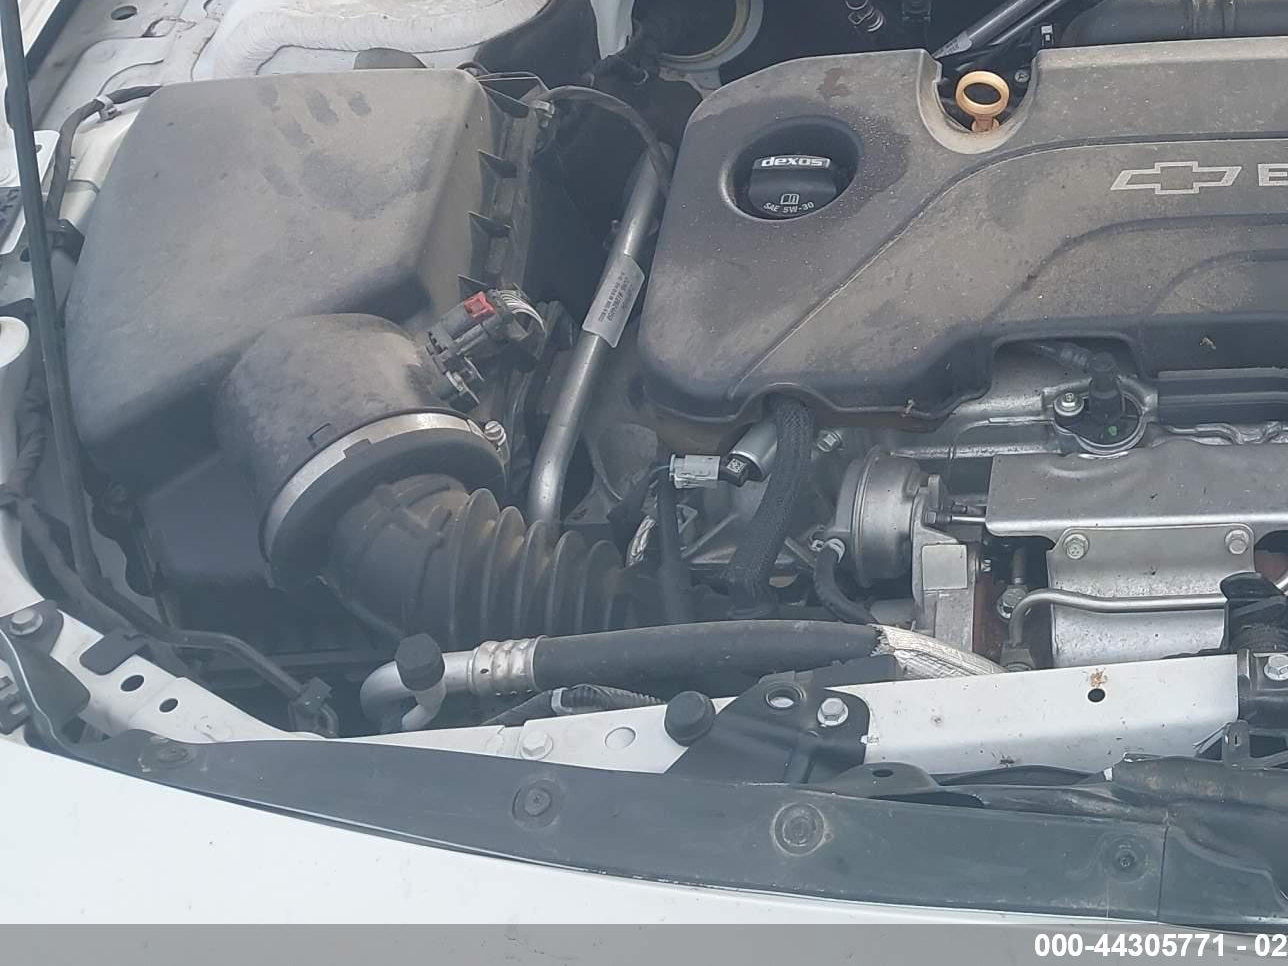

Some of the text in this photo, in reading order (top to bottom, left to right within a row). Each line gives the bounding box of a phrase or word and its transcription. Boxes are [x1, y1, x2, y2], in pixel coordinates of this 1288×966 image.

[761, 156, 823, 167] dexos
[763, 201, 815, 213] SAE 5W-30
